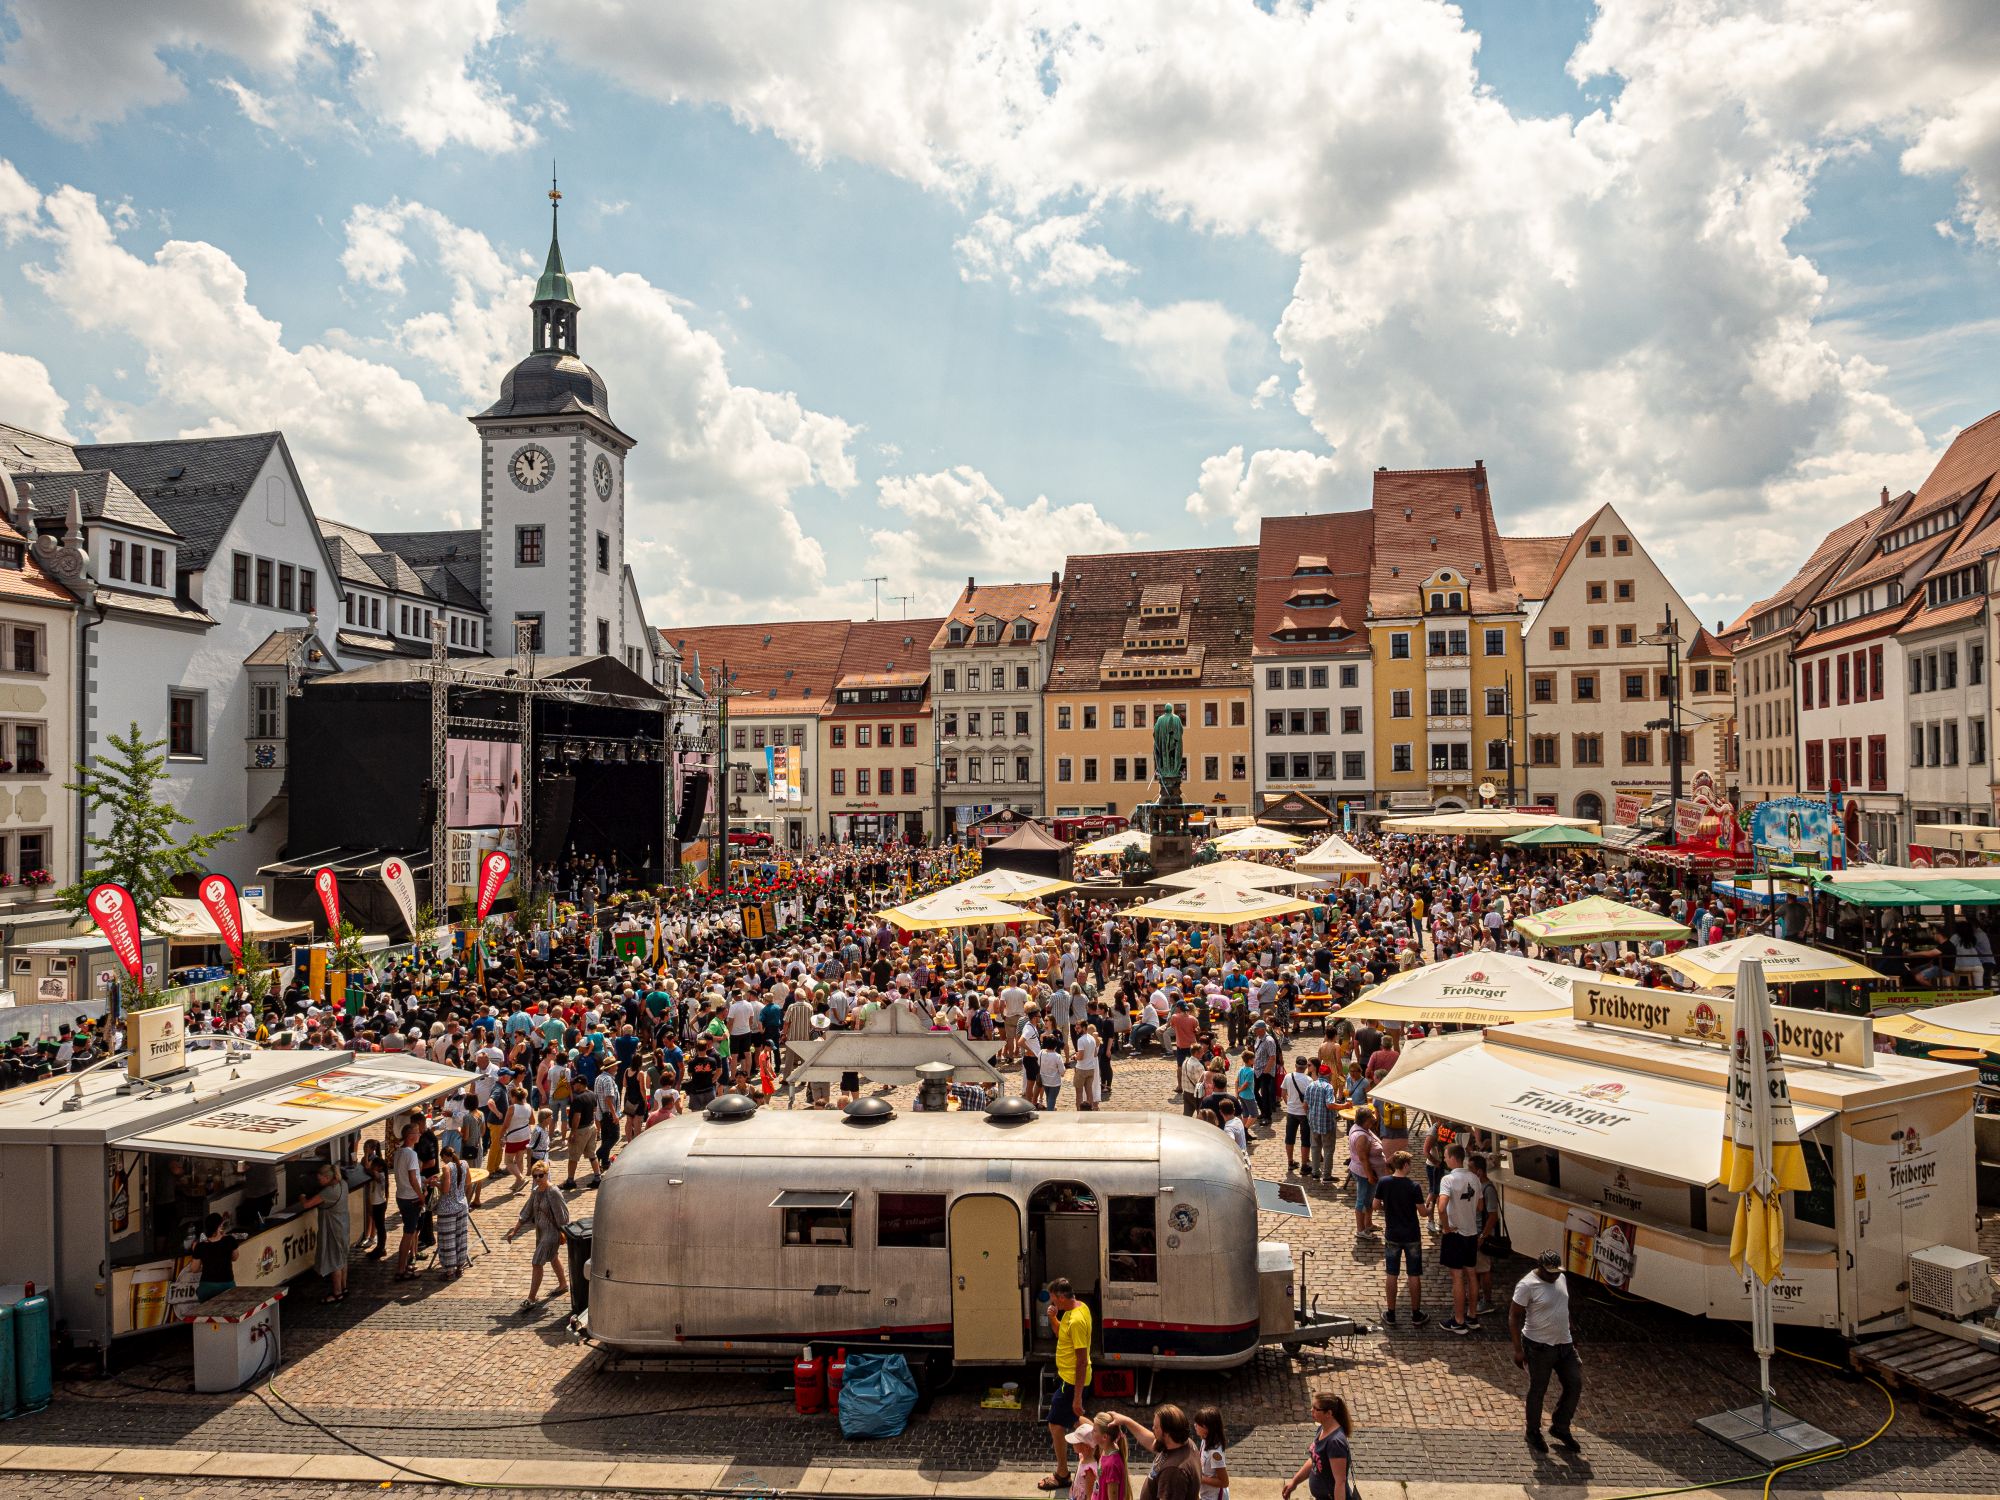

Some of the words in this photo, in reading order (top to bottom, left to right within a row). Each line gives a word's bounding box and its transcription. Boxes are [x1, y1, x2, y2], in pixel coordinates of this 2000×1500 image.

[452, 833, 472, 850] BLEIB
[452, 862, 471, 884] BIER
[480, 870, 497, 911] HITRADIO
[492, 856, 504, 872] RTL
[1442, 985, 1507, 998] Freiberger
[1420, 1011, 1446, 1020] BLEIB
[1447, 1012, 1464, 1020] WIE
[1465, 1012, 1488, 1022] DEIN
[1587, 990, 1671, 1029] Freiberger
[1774, 1017, 1845, 1057] iberger
[150, 1040, 182, 1056] Freiberger
[1507, 1091, 1631, 1127] Freiberger
[189, 1112, 250, 1129] BLEIB
[239, 1117, 309, 1134] BIER
[1889, 1160, 1936, 1190] Freiberger
[1603, 1187, 1642, 1211] Freiberger
[282, 1226, 317, 1266] Freib
[170, 1282, 197, 1299] Freib
